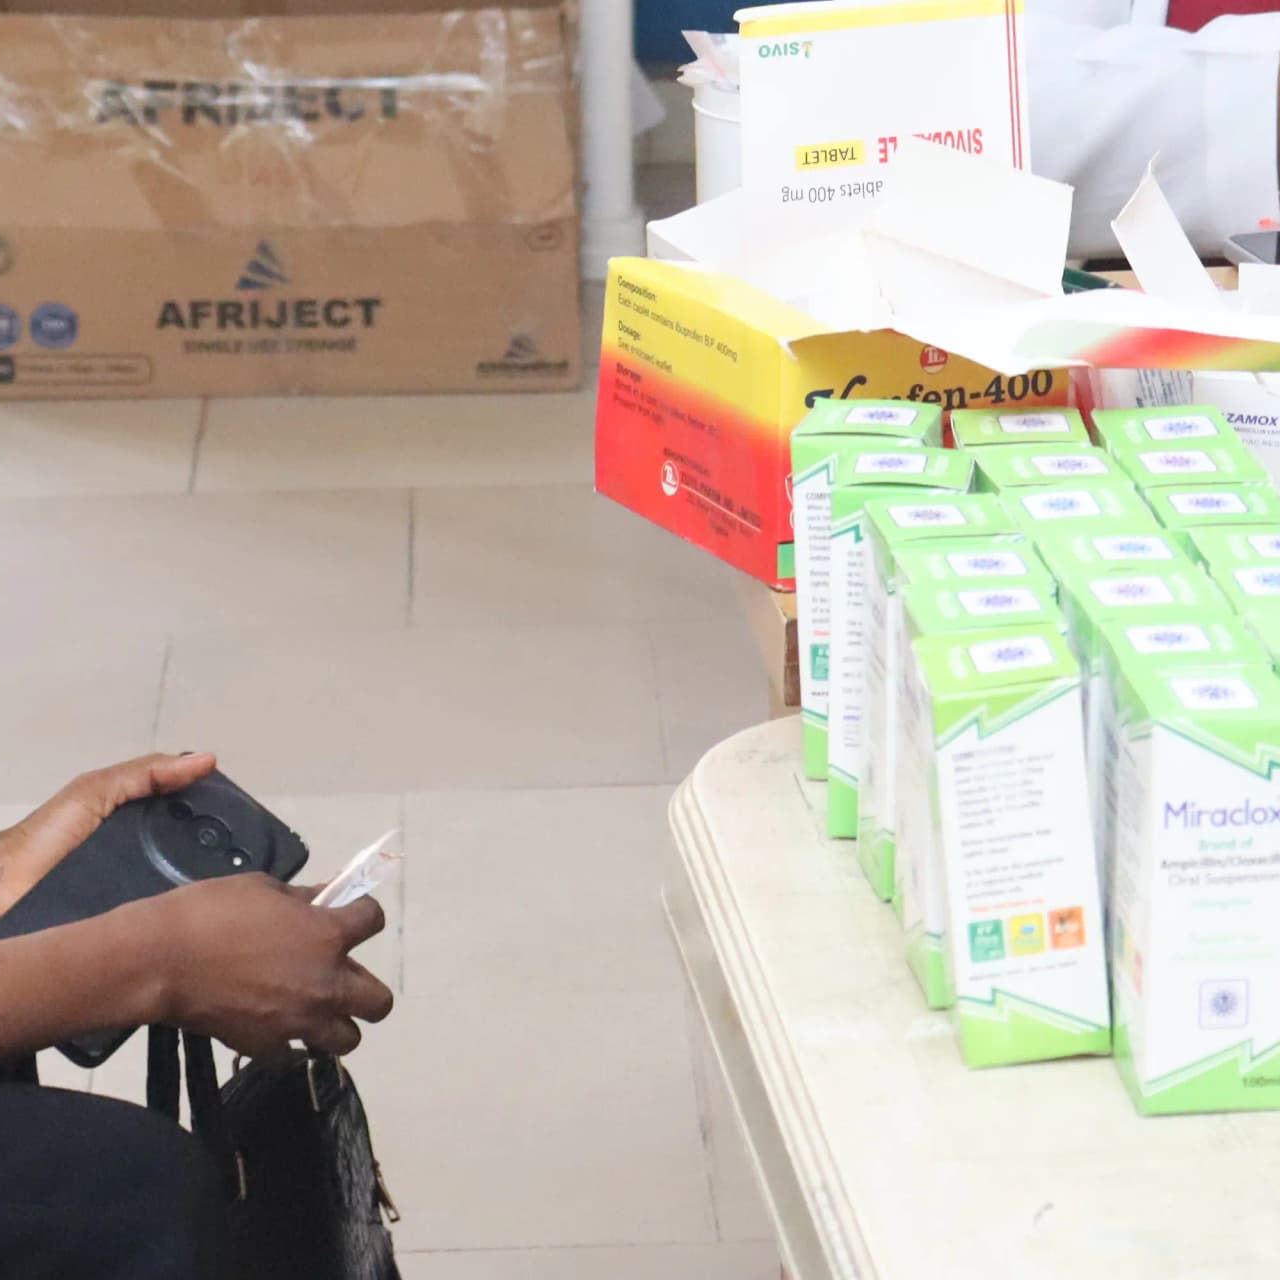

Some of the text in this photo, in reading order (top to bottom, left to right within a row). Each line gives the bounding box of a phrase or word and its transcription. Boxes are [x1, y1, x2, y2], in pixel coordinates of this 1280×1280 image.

[759, 41, 799, 59] SIVO
[802, 147, 858, 166] TABLET
[781, 180, 884, 204] ablets 400 mg
[156, 299, 384, 329] AFRIJECT
[1222, 412, 1279, 428] ZAMOX
